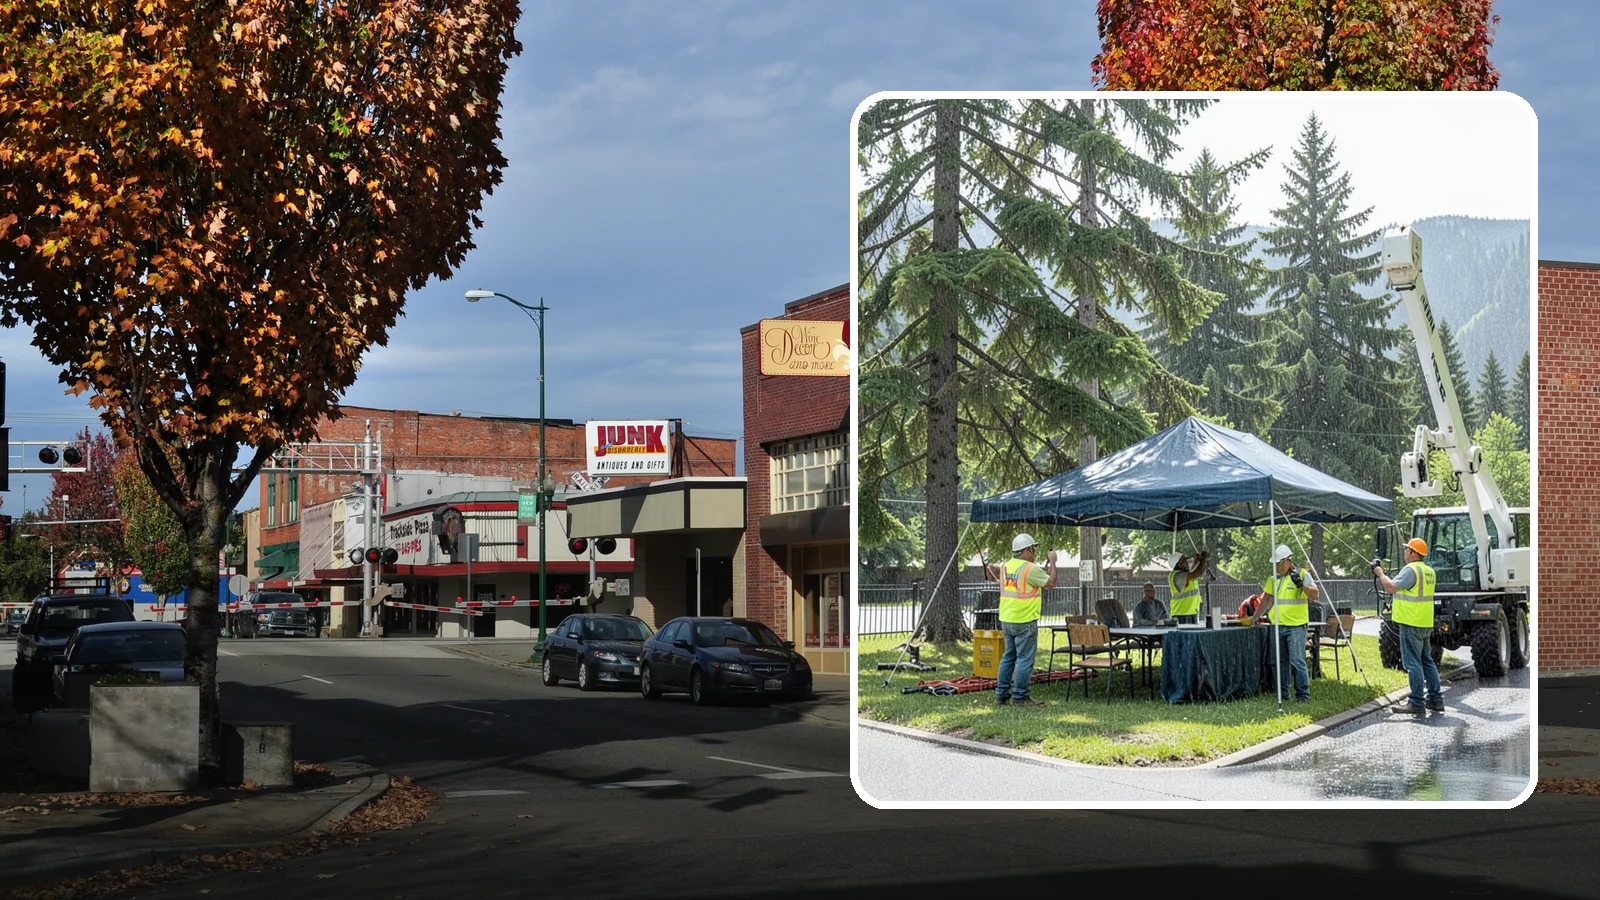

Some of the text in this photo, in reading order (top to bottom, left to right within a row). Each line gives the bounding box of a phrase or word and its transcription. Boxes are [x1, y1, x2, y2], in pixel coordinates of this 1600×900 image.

[596, 425, 665, 457] JUNK
[607, 446, 646, 454] DISORDERLY
[597, 460, 665, 470] ANTIQUES AND GIFTS
